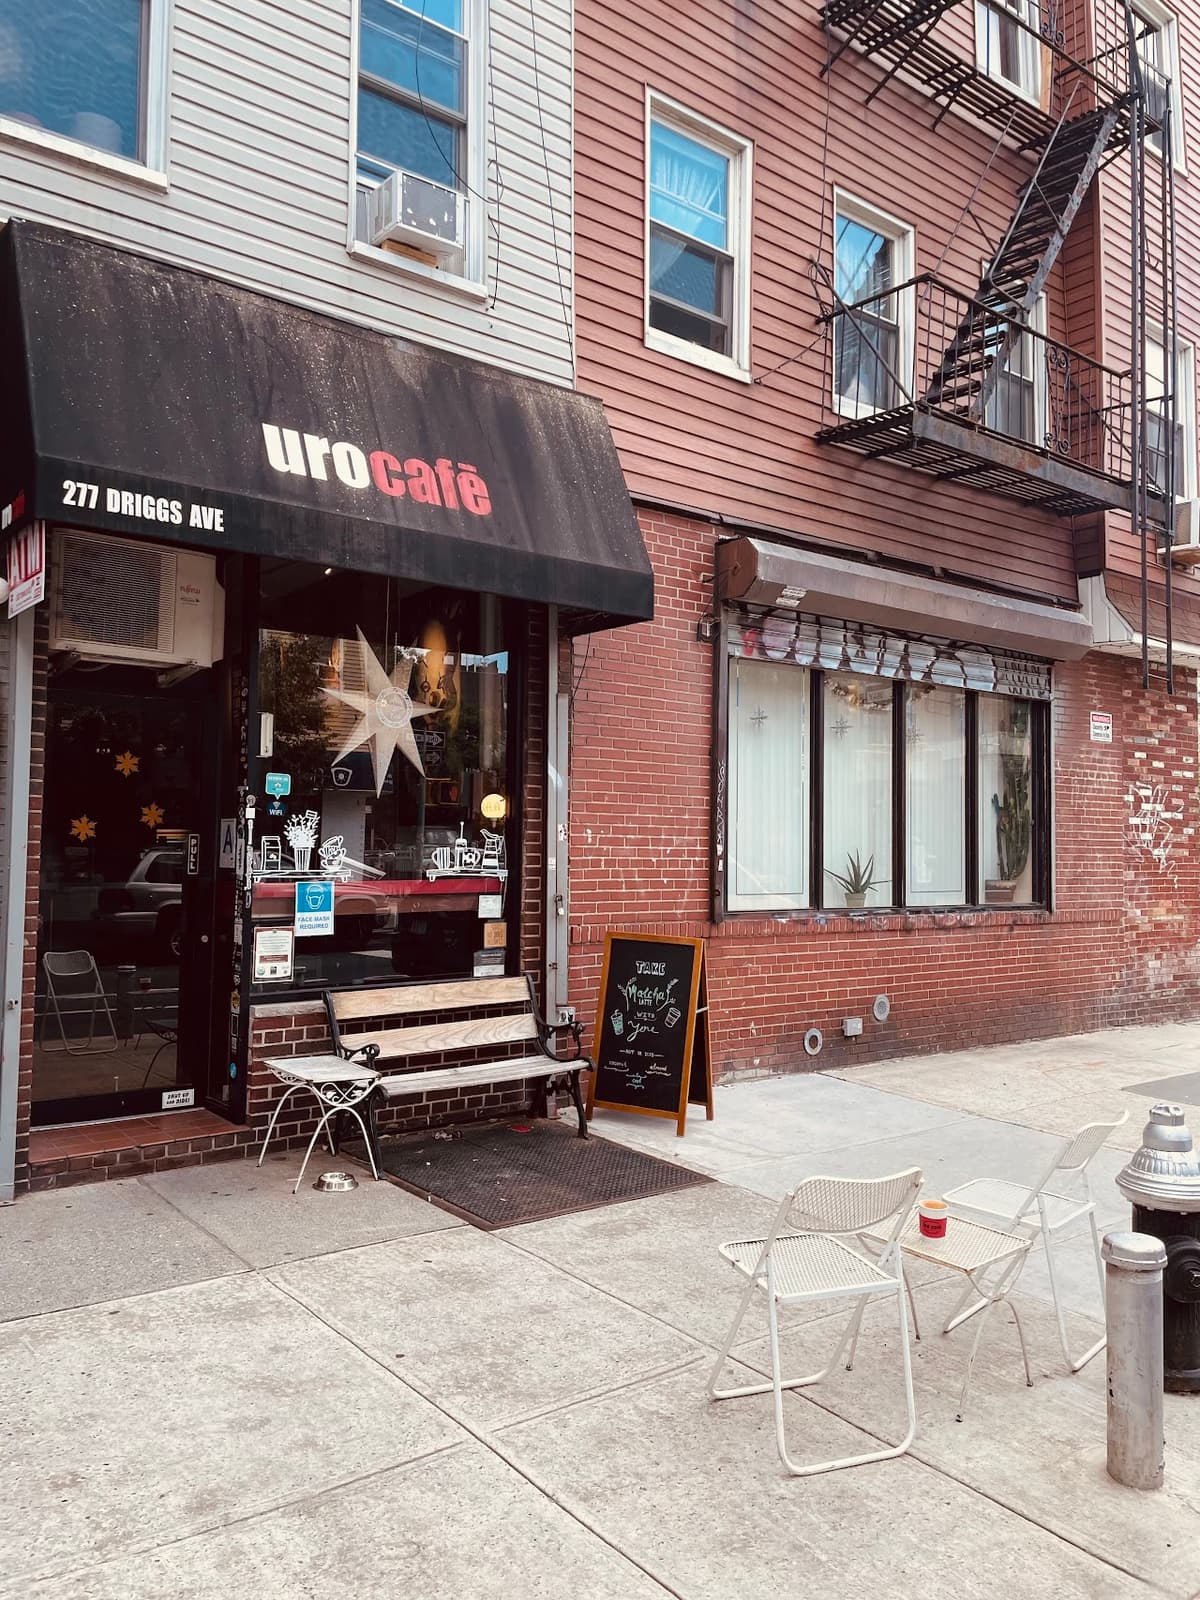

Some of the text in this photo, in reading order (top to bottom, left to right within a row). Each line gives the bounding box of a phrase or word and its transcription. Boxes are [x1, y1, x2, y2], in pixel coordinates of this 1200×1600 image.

[62, 480, 225, 532] 277 DRIGGS AVE
[190, 838, 198, 870] PULL
[222, 824, 233, 854] A
[299, 922, 329, 930] REQUIRED
[636, 961, 666, 976] TAKE
